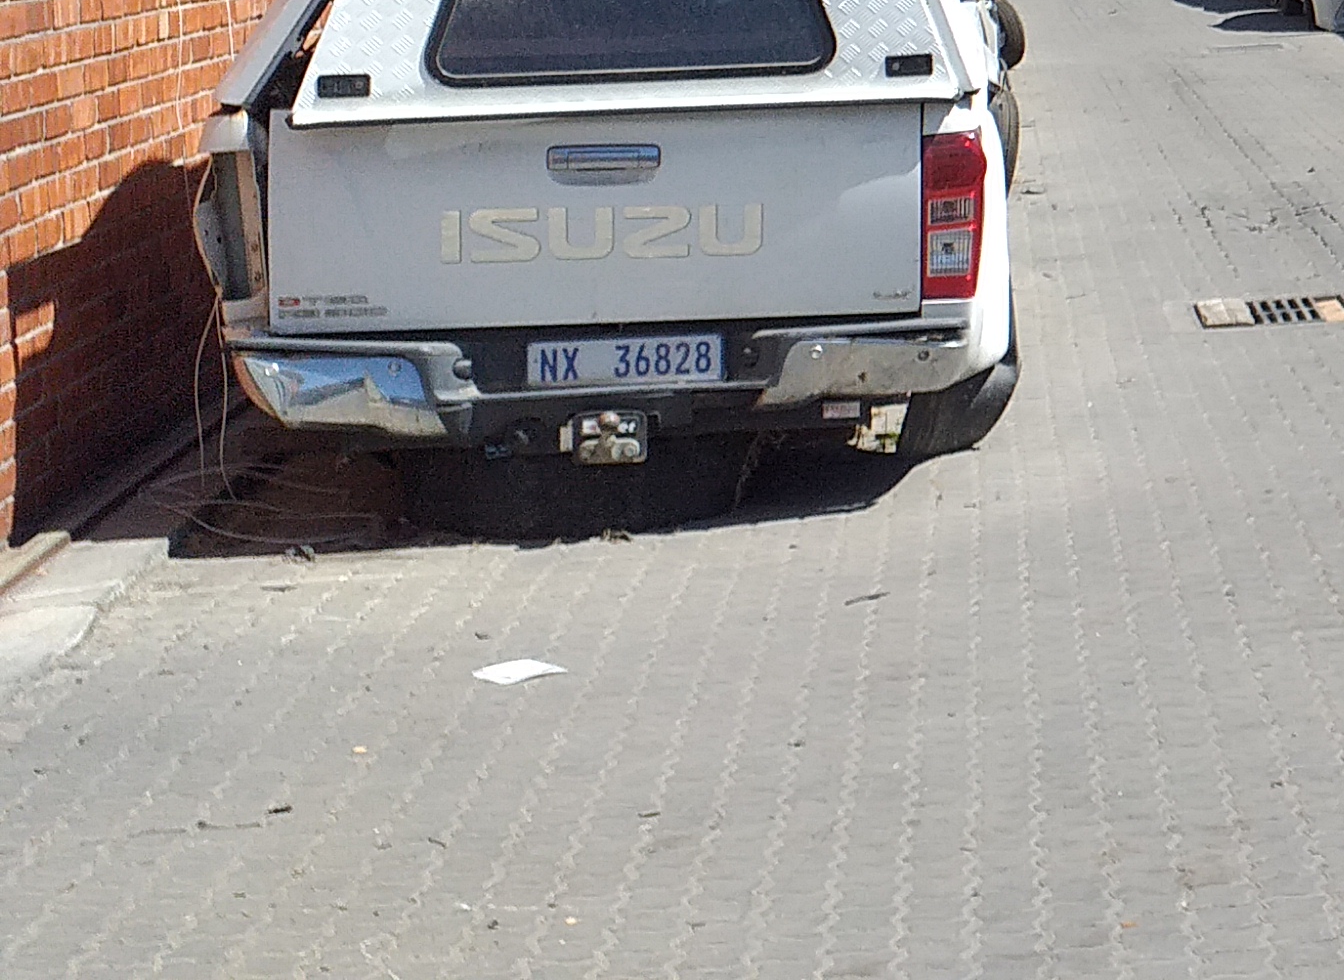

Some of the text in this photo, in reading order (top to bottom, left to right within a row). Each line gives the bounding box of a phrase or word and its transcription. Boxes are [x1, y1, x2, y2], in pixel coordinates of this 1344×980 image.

[441, 203, 764, 265] ISUZU
[540, 341, 712, 383] NX 36828
